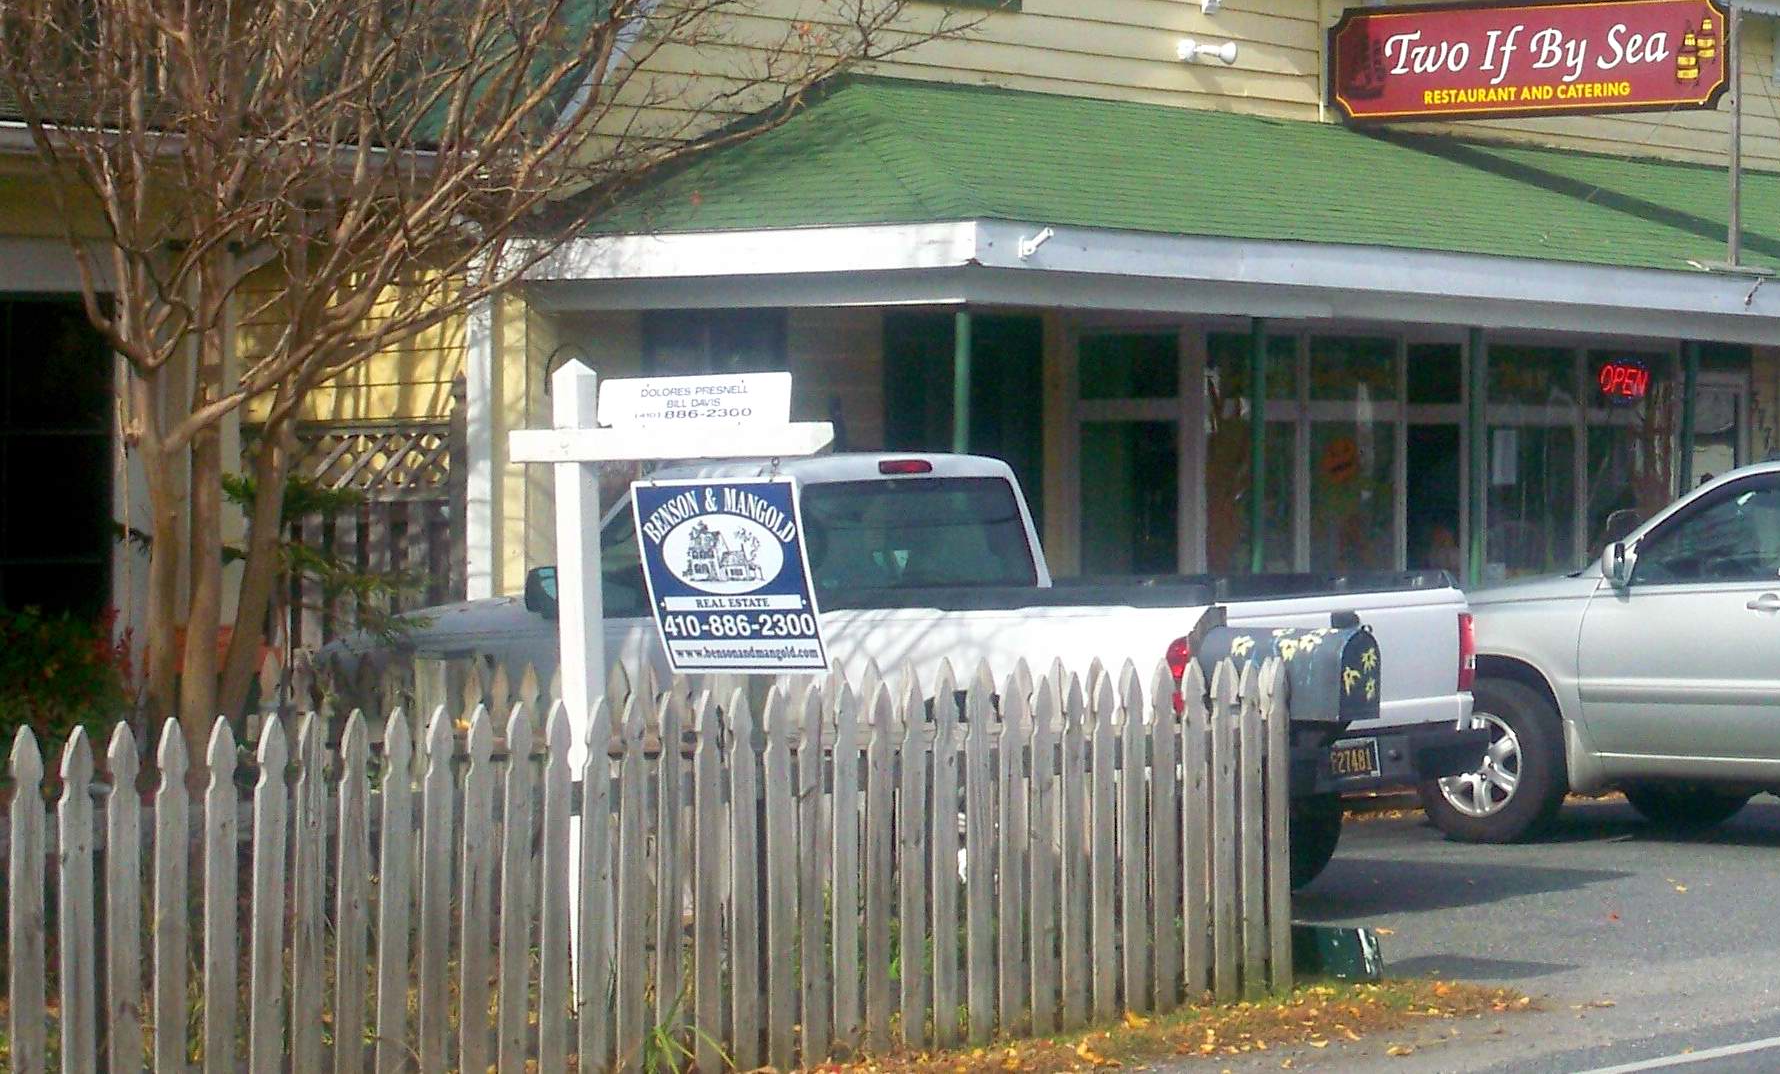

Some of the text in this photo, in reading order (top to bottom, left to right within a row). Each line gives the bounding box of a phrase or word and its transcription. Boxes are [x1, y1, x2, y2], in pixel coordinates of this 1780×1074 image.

[1384, 23, 1670, 85] Two If By Sea
[1424, 82, 1631, 105] RESTAURANT AND CATERING
[1600, 362, 1649, 397] OPEN
[640, 387, 691, 398] DOLORES
[666, 397, 721, 409] BILL DAVIS
[664, 407, 752, 420] 886-2300
[643, 487, 796, 545] BENSON & MANGOLD
[696, 597, 770, 609] REAL ESTATE
[665, 613, 816, 637] 410-886-2300
[675, 645, 819, 662] www.bensonandmangold.com
